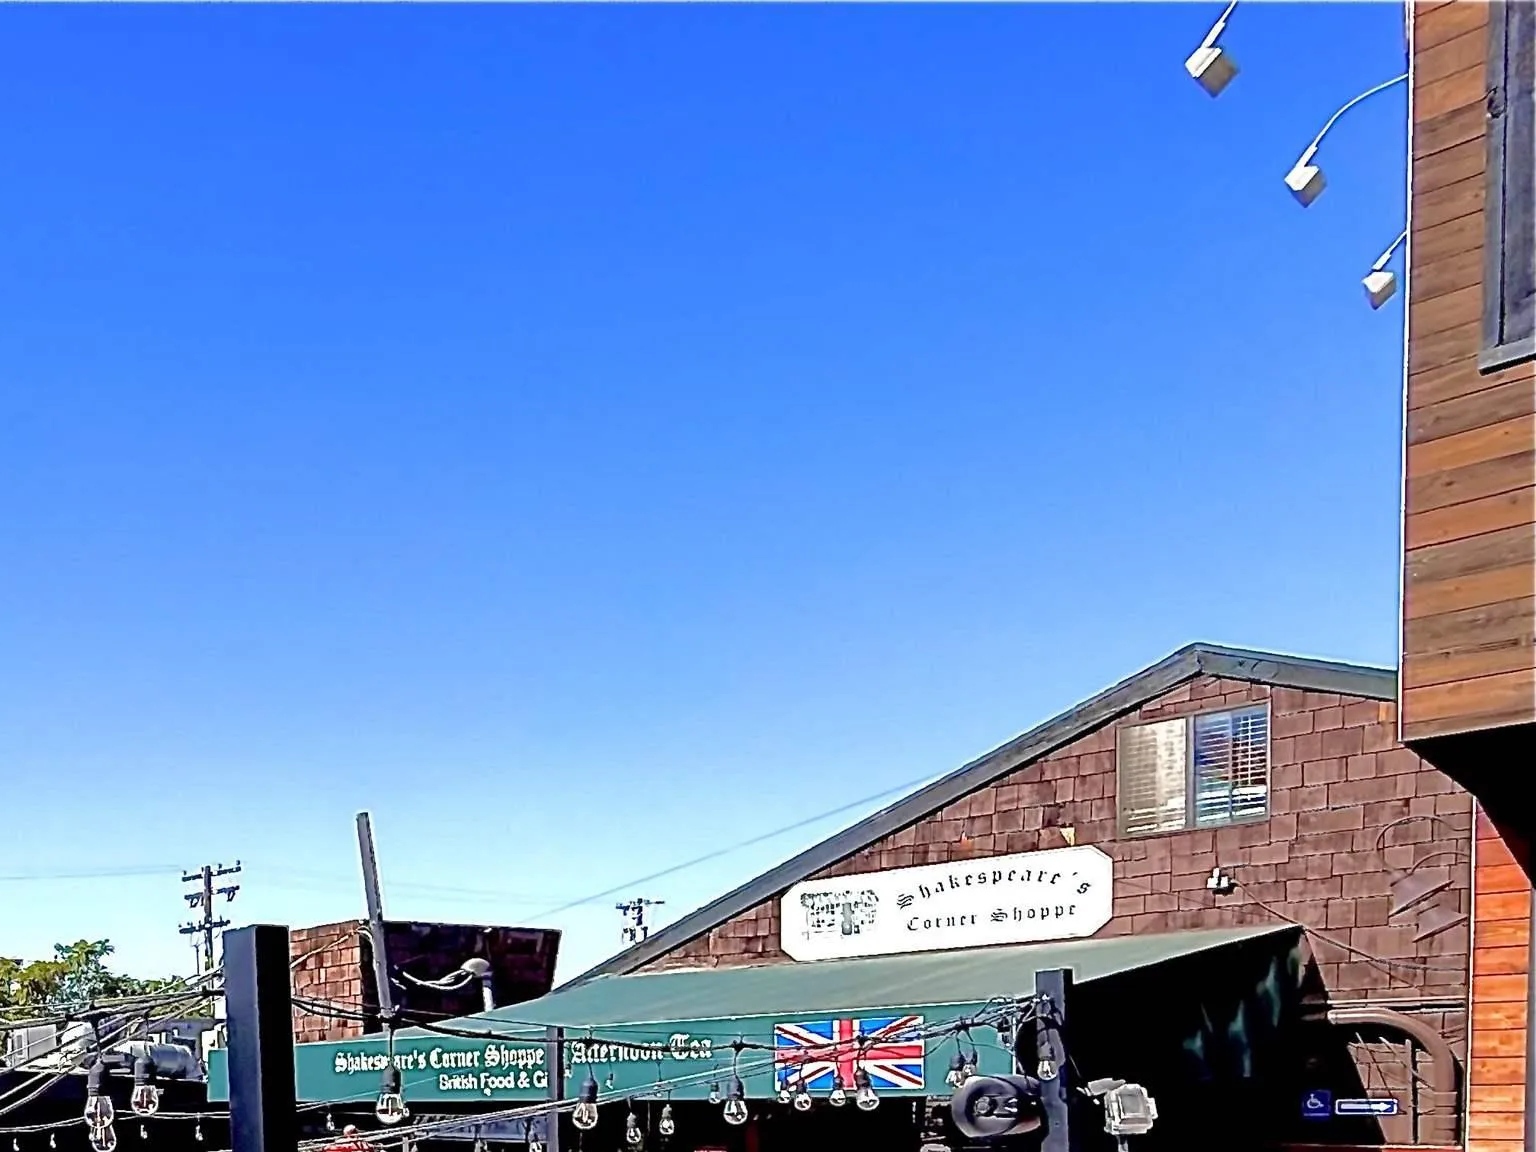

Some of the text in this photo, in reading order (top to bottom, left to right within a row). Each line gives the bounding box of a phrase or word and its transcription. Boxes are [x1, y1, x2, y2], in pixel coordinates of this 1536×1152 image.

[896, 869, 1092, 910] Shakespeare's
[907, 904, 1076, 931] Corner Shoppe
[335, 1044, 545, 1075] Shakespare's Corner Shoppe
[670, 1033, 712, 1060] Tea
[439, 1073, 478, 1090] British
[480, 1071, 515, 1089] Food
[517, 1070, 530, 1089] &
